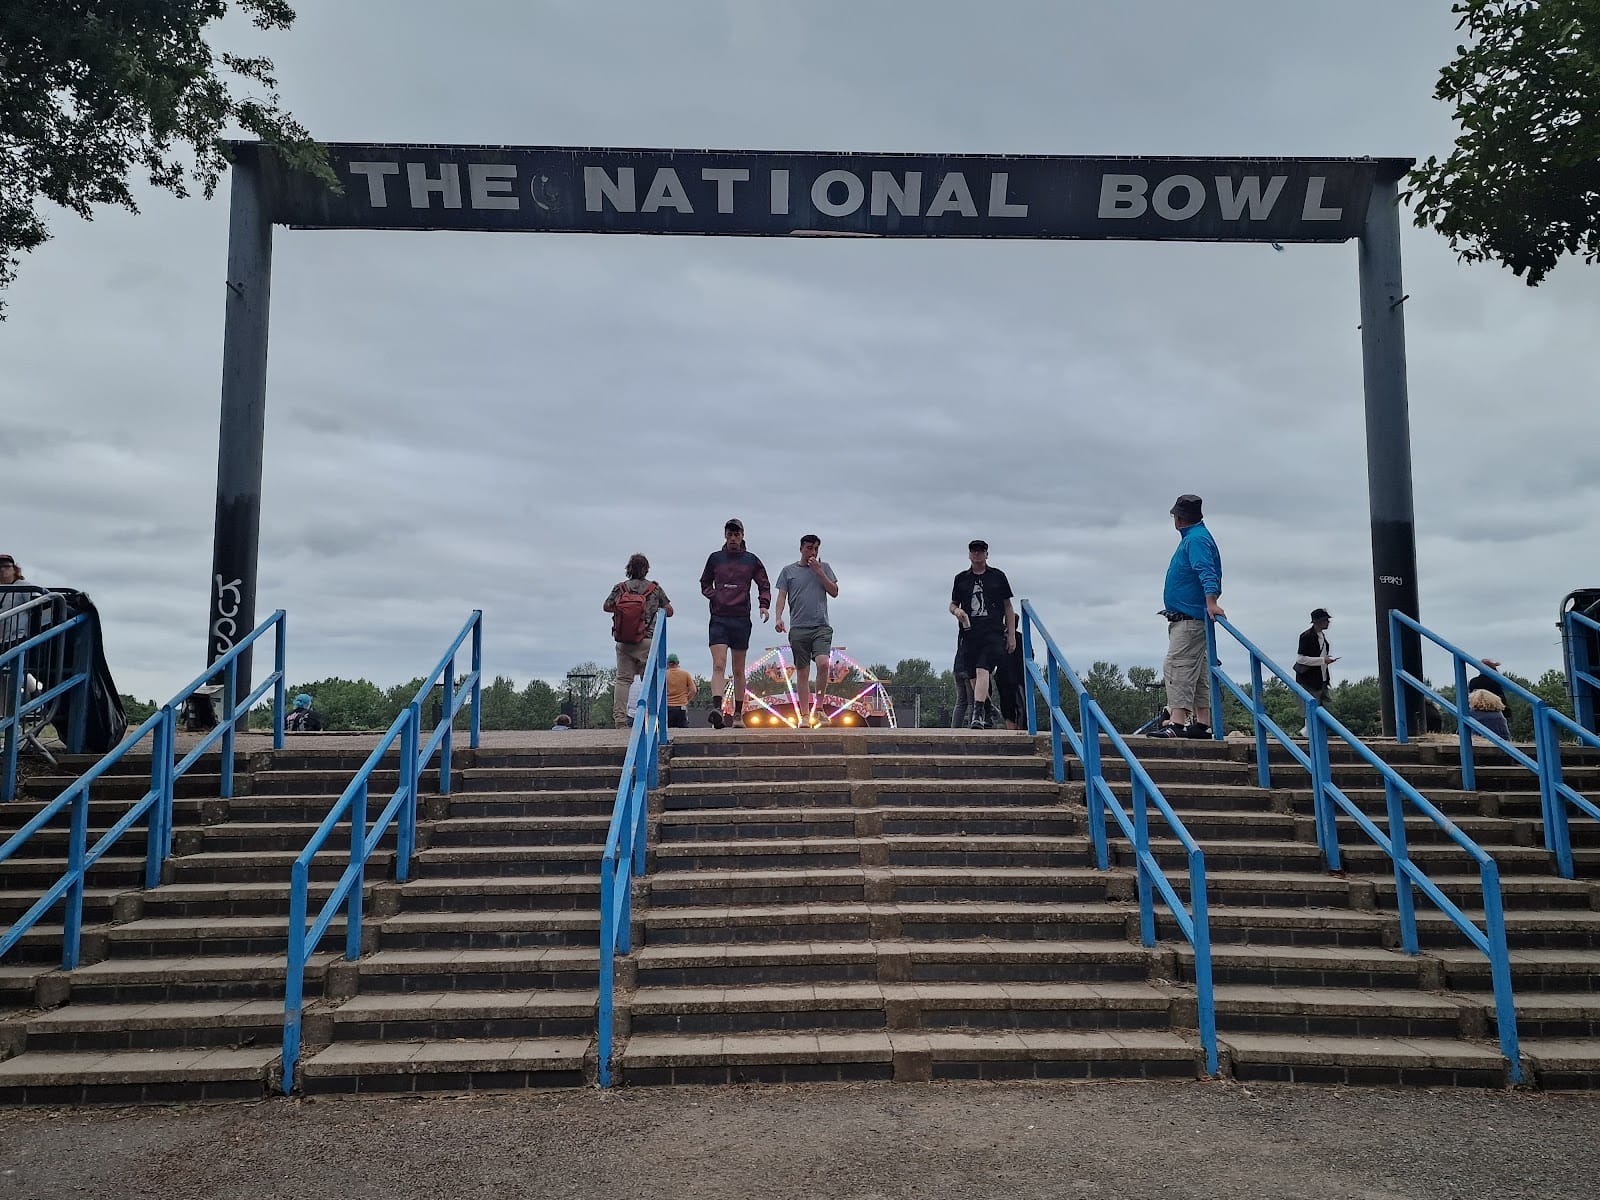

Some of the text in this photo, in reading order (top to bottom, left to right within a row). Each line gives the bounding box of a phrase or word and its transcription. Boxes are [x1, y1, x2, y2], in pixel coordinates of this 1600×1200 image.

[349, 160, 1344, 222] THE NATIONAL BOWL
